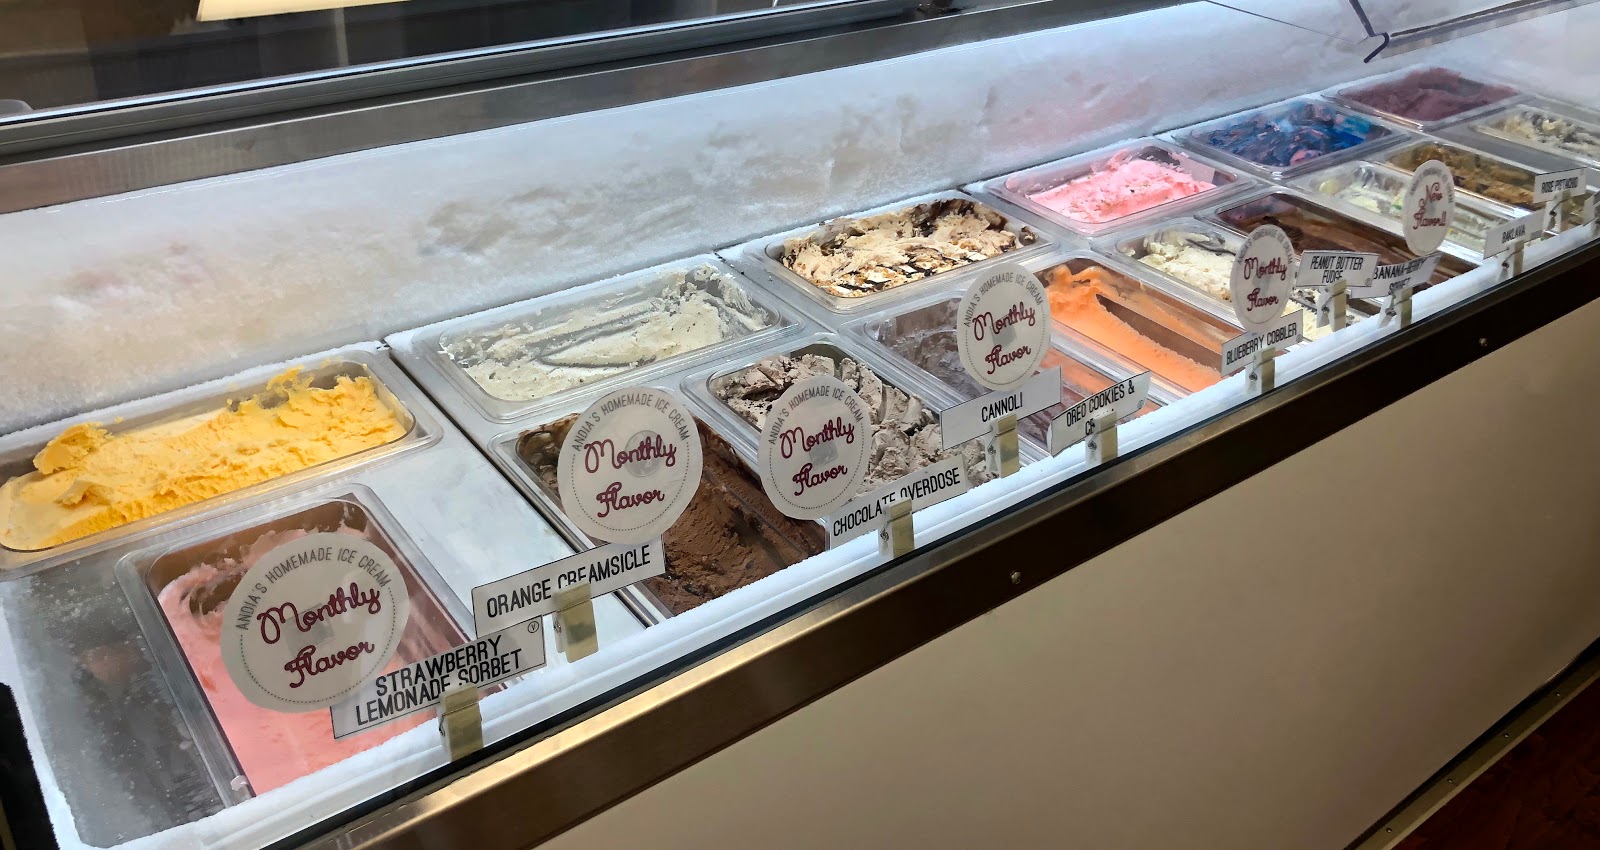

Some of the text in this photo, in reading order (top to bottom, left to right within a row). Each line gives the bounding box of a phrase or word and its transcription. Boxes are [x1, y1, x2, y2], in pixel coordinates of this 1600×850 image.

[1244, 257, 1287, 281] Monthly
[1310, 256, 1364, 270] PEANUT BUTTER
[963, 272, 1043, 327] ANDIA'S HOMEMADE ICE CREAM
[972, 301, 1036, 341] Monthly
[1247, 287, 1279, 312] Flavor
[985, 344, 1032, 375] Flavor
[1227, 322, 1297, 365] BLUEBERRY COBBLER
[572, 393, 691, 452] ANDIA'S HOMEMADE ICE CREAM
[768, 385, 864, 445] ANDIA'S HOMEMADE ICE CREAM
[981, 391, 1023, 422] CANNOLI
[1066, 403, 1086, 427] OREO
[1088, 384, 1125, 414] COOKIES
[1128, 379, 1135, 395] &
[584, 434, 676, 474] Monthly
[779, 416, 855, 459] Monthly
[596, 481, 665, 518] Flavor
[792, 462, 848, 496] Flavor
[833, 467, 960, 537] CHOCOLATE OVERDOSE
[236, 547, 392, 631] ANDIA'S HOMEMADE ICE CREAM
[487, 544, 651, 618] ORANGE CREAMSICLE
[256, 582, 381, 644] Monthly
[284, 641, 375, 688] Flavor
[356, 648, 522, 725] LEMONADE SORBET
[375, 635, 501, 696] STRAWBERRY
